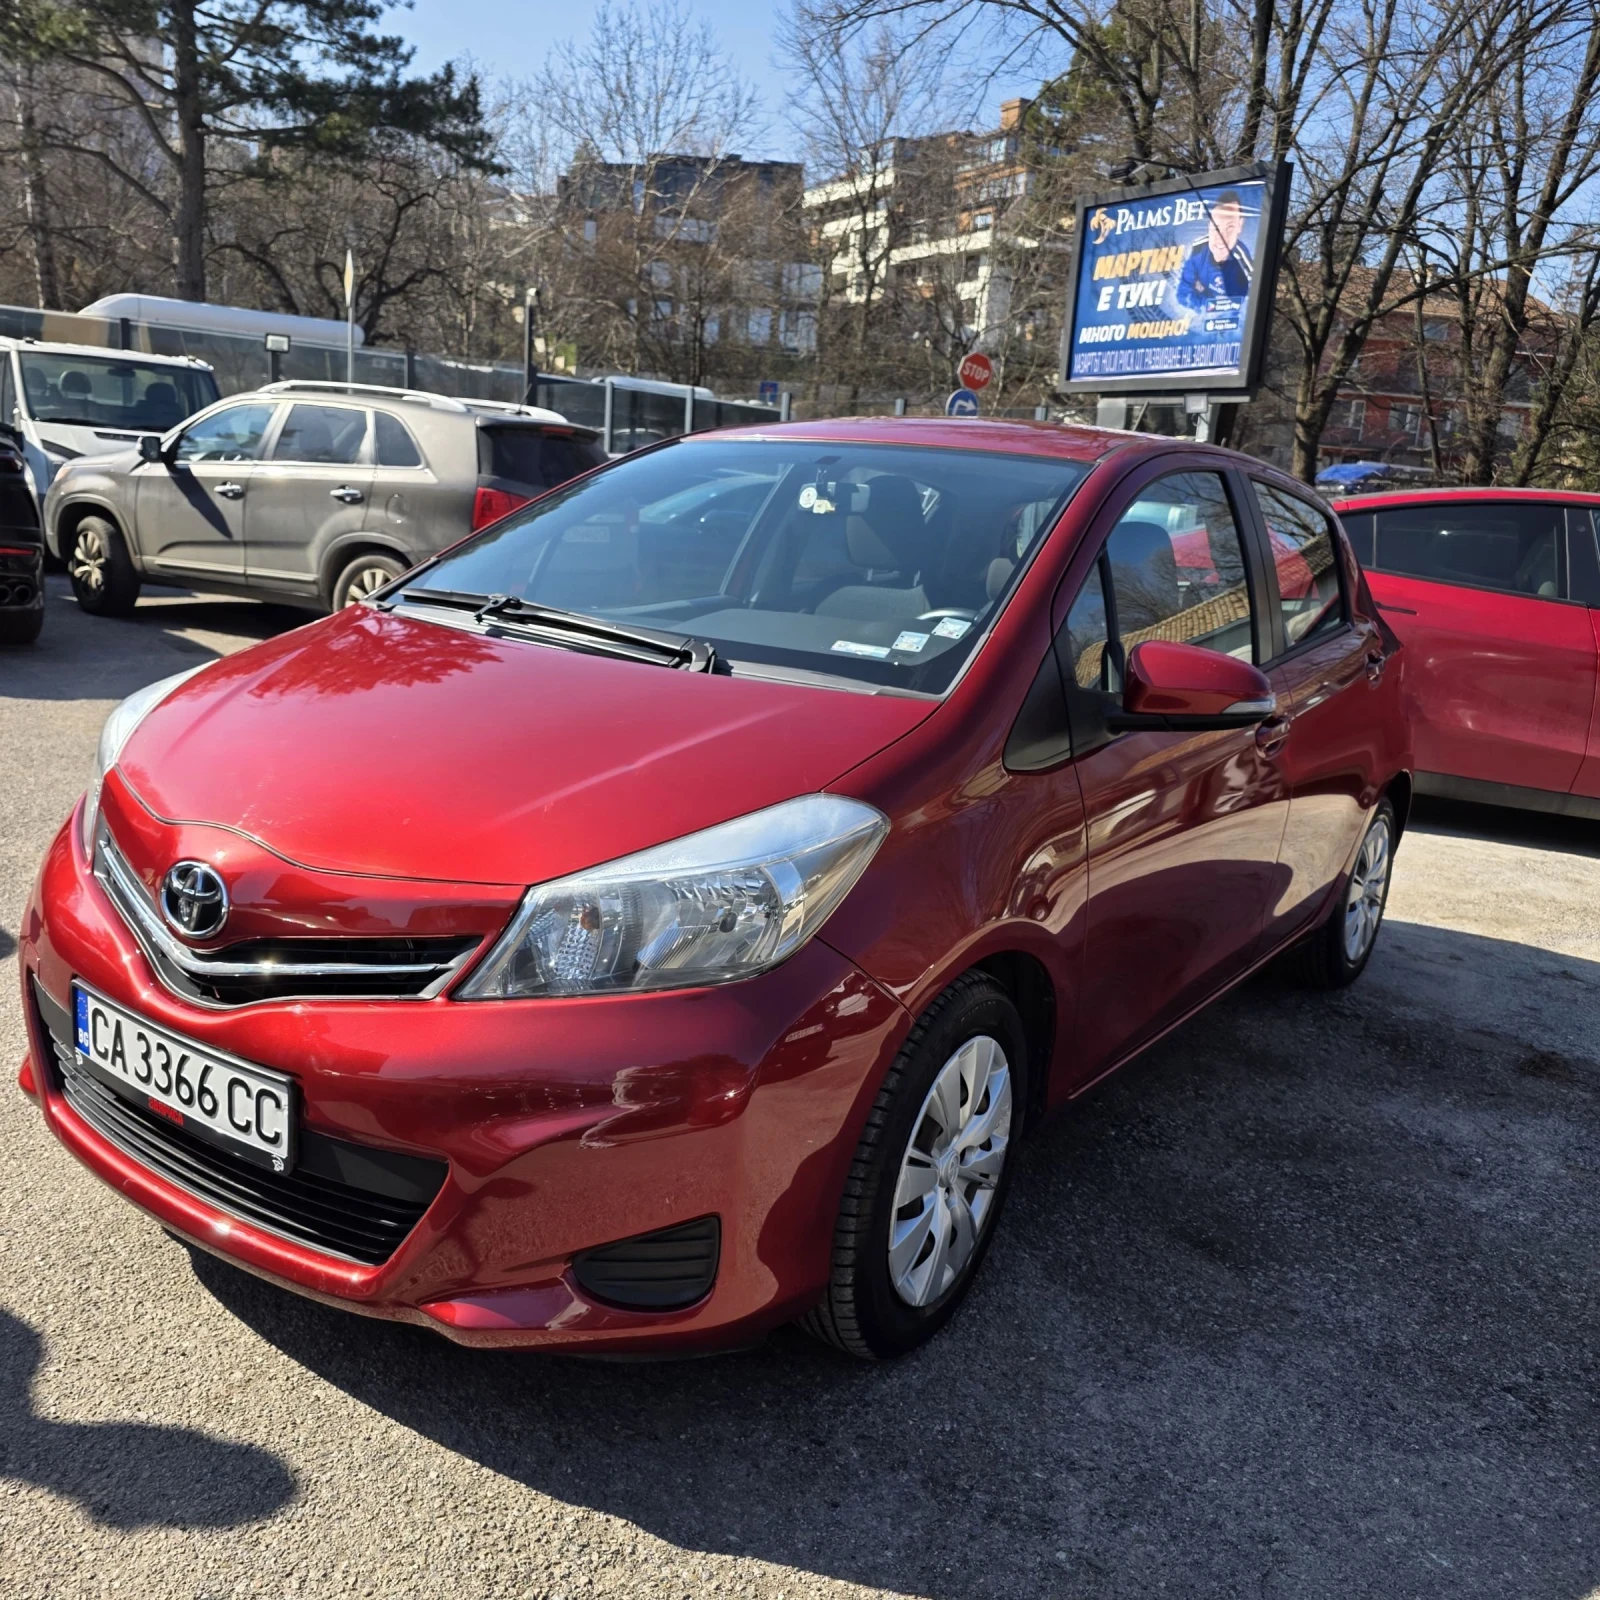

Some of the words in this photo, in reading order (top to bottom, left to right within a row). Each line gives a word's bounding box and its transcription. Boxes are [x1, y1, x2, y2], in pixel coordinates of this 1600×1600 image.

[1094, 246, 1184, 280] МАРТИН
[1117, 280, 1166, 309] ТУК!
[1079, 324, 1126, 344] МНОГО
[1127, 319, 1190, 339] МОЩНО!
[963, 362, 989, 382] STOP
[78, 1027, 89, 1048] BG
[134, 1031, 218, 1118] 3366
